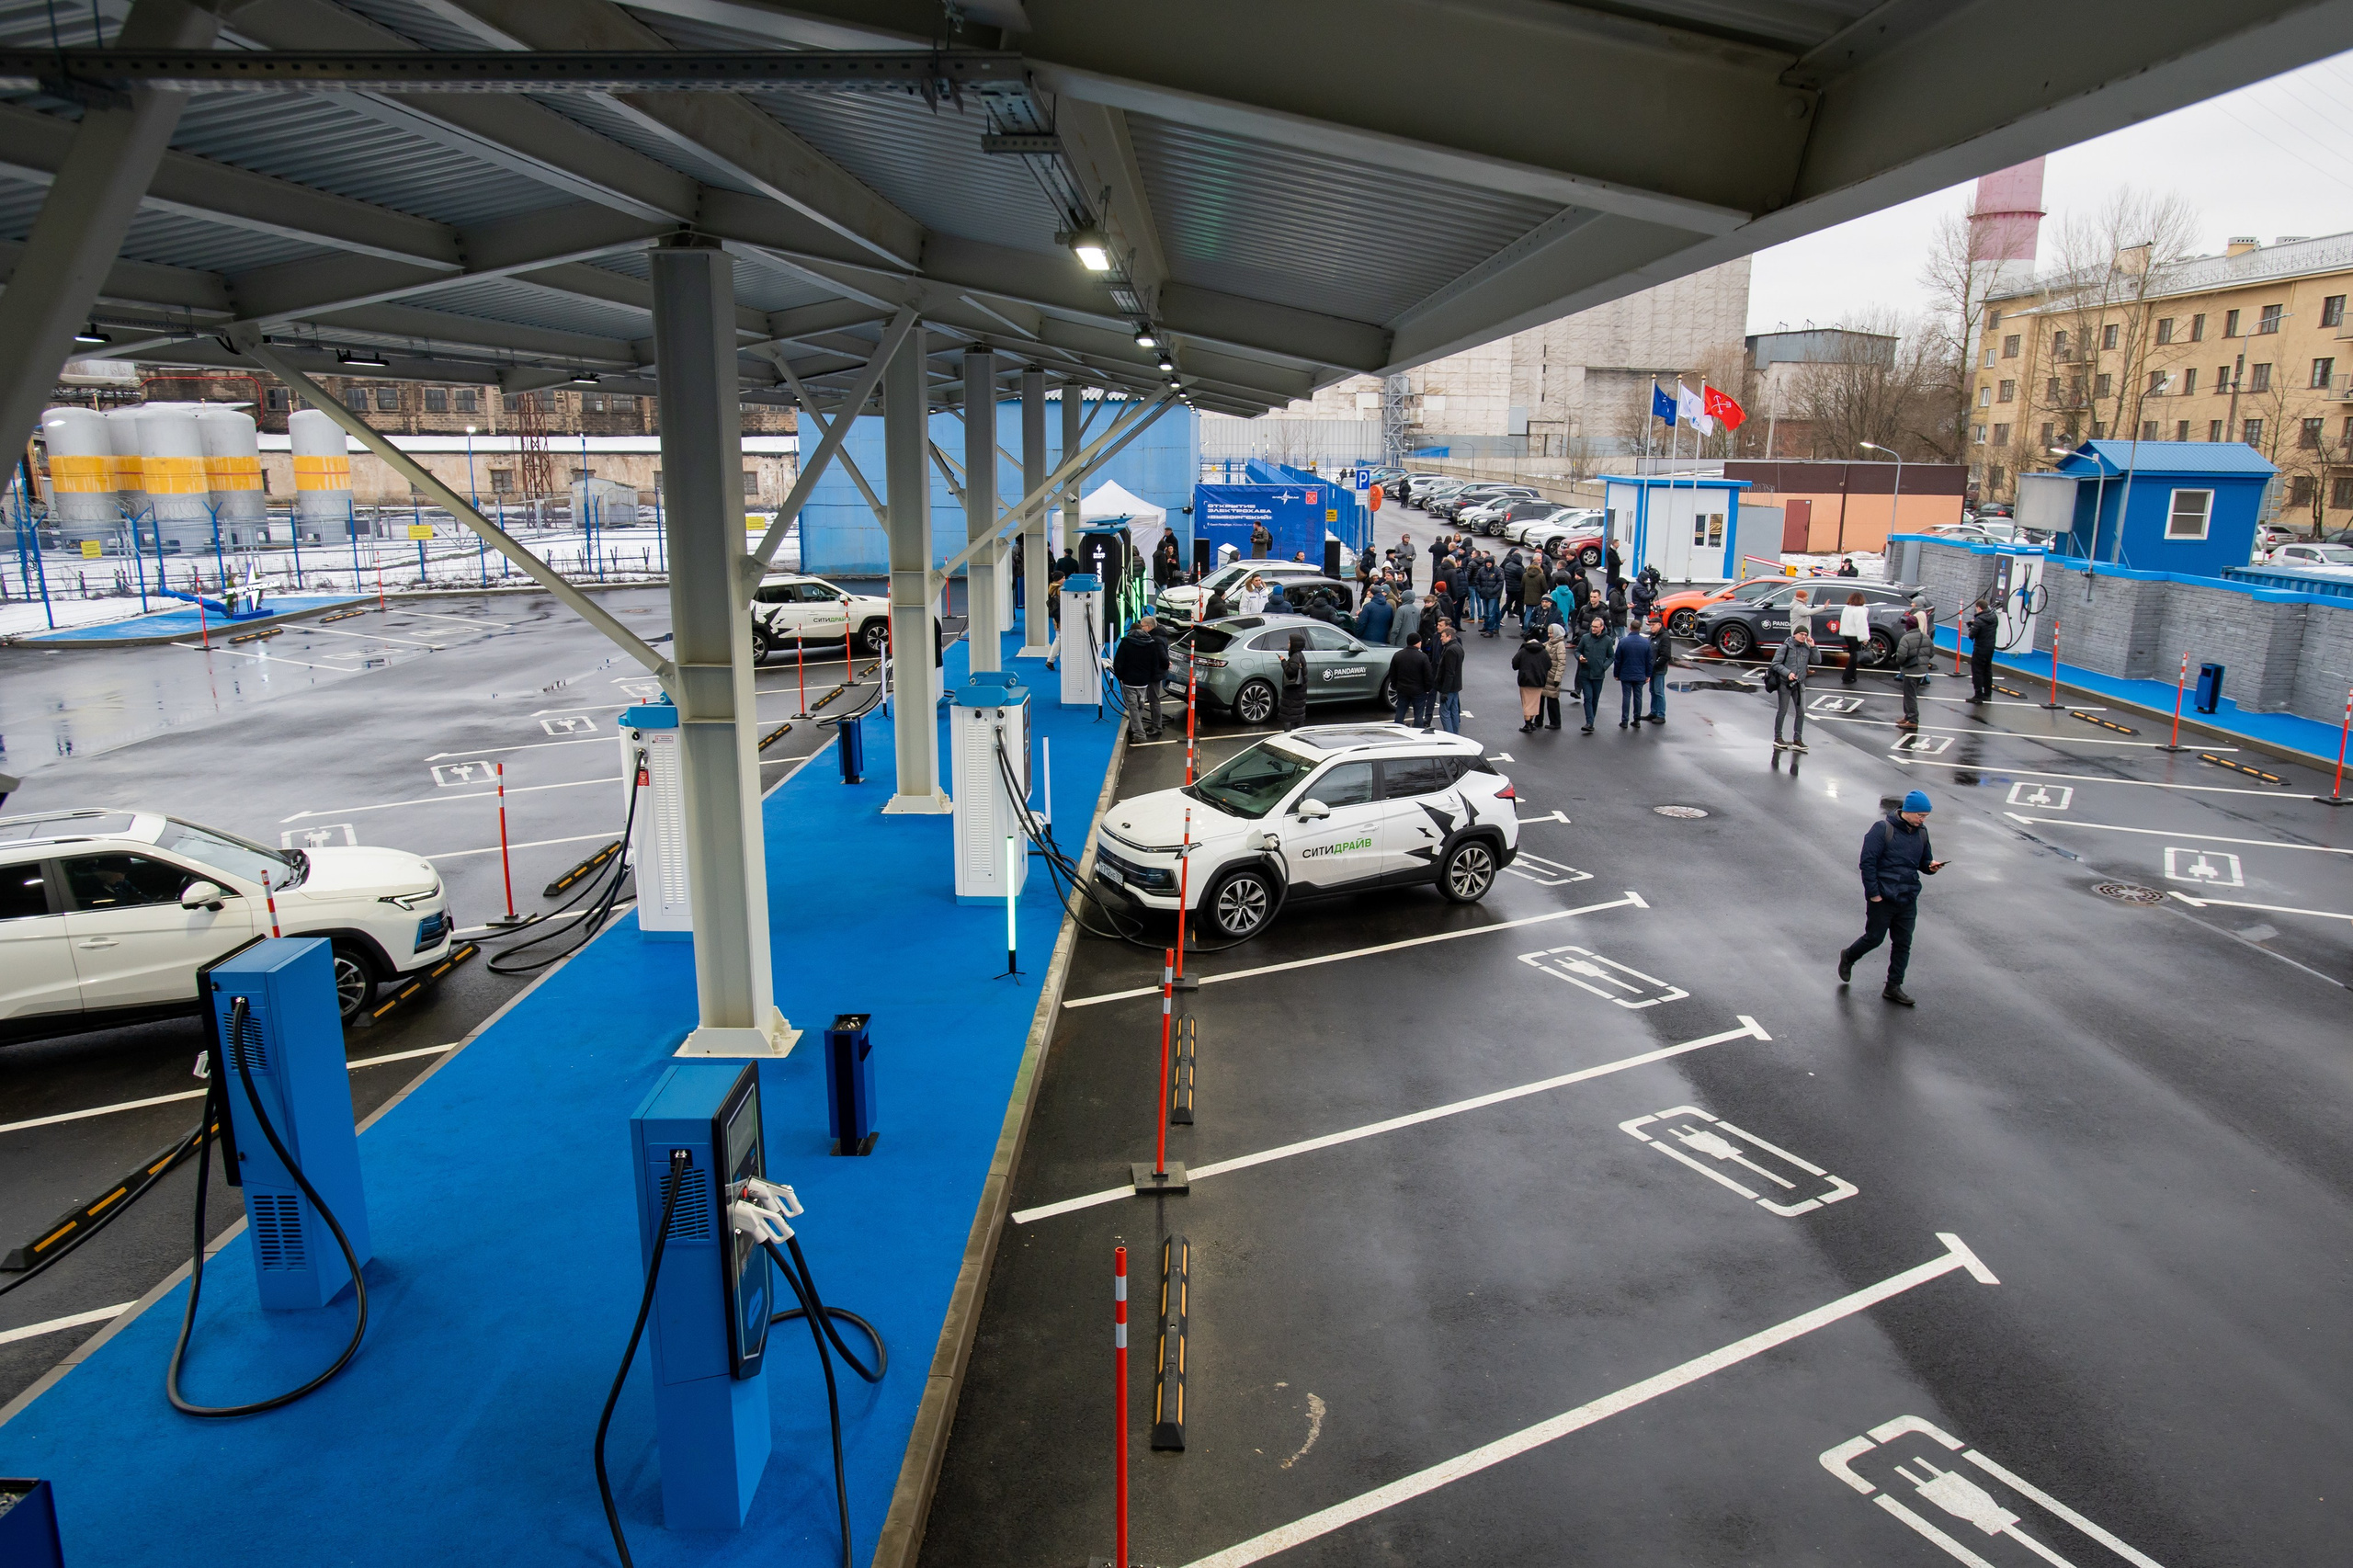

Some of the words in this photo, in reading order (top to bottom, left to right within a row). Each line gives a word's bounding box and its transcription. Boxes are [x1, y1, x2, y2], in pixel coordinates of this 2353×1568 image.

[1359, 472, 1368, 488] P
[1334, 666, 1368, 676] PANDAWAY
[1302, 837, 1372, 858] СИТИДРАЙВ
